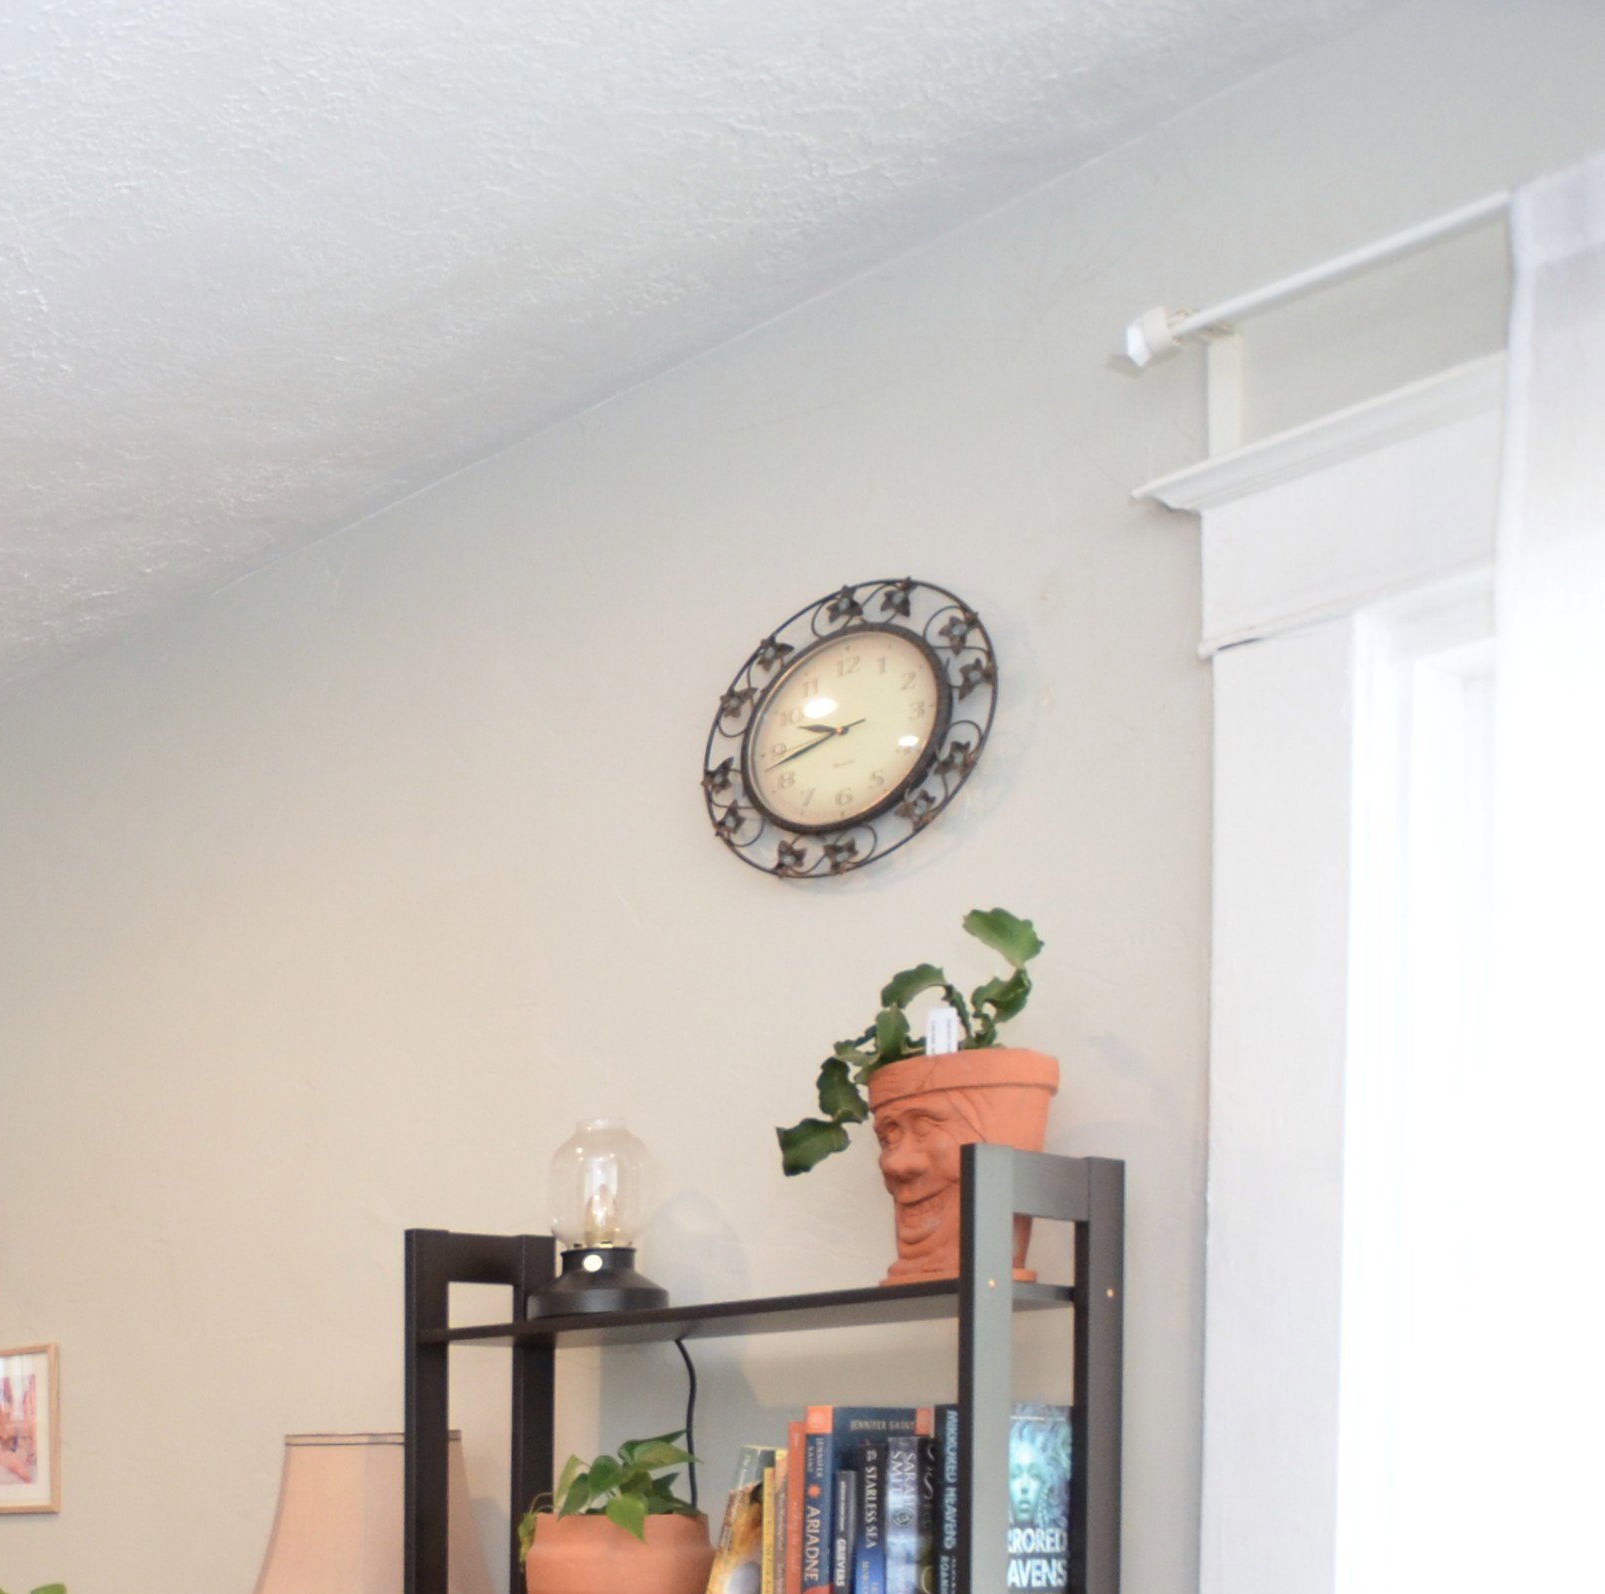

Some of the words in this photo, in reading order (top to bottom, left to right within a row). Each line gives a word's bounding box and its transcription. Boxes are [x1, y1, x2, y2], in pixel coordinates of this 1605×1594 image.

[837, 656, 862, 677] 12
[879, 657, 888, 674] 1
[901, 672, 917, 691] 2
[912, 702, 926, 721] 3
[772, 743, 788, 759] 9
[779, 771, 795, 791] 8
[870, 769, 885, 790] 5
[801, 789, 816, 808] 7
[834, 789, 853, 806] 6
[864, 1466, 878, 1524] STARLESS
[943, 1486, 958, 1550] HEAVENS
[805, 1505, 823, 1582] ARIADNE
[864, 1525, 878, 1550] SEA
[835, 1538, 847, 1588] GRIEVERS
